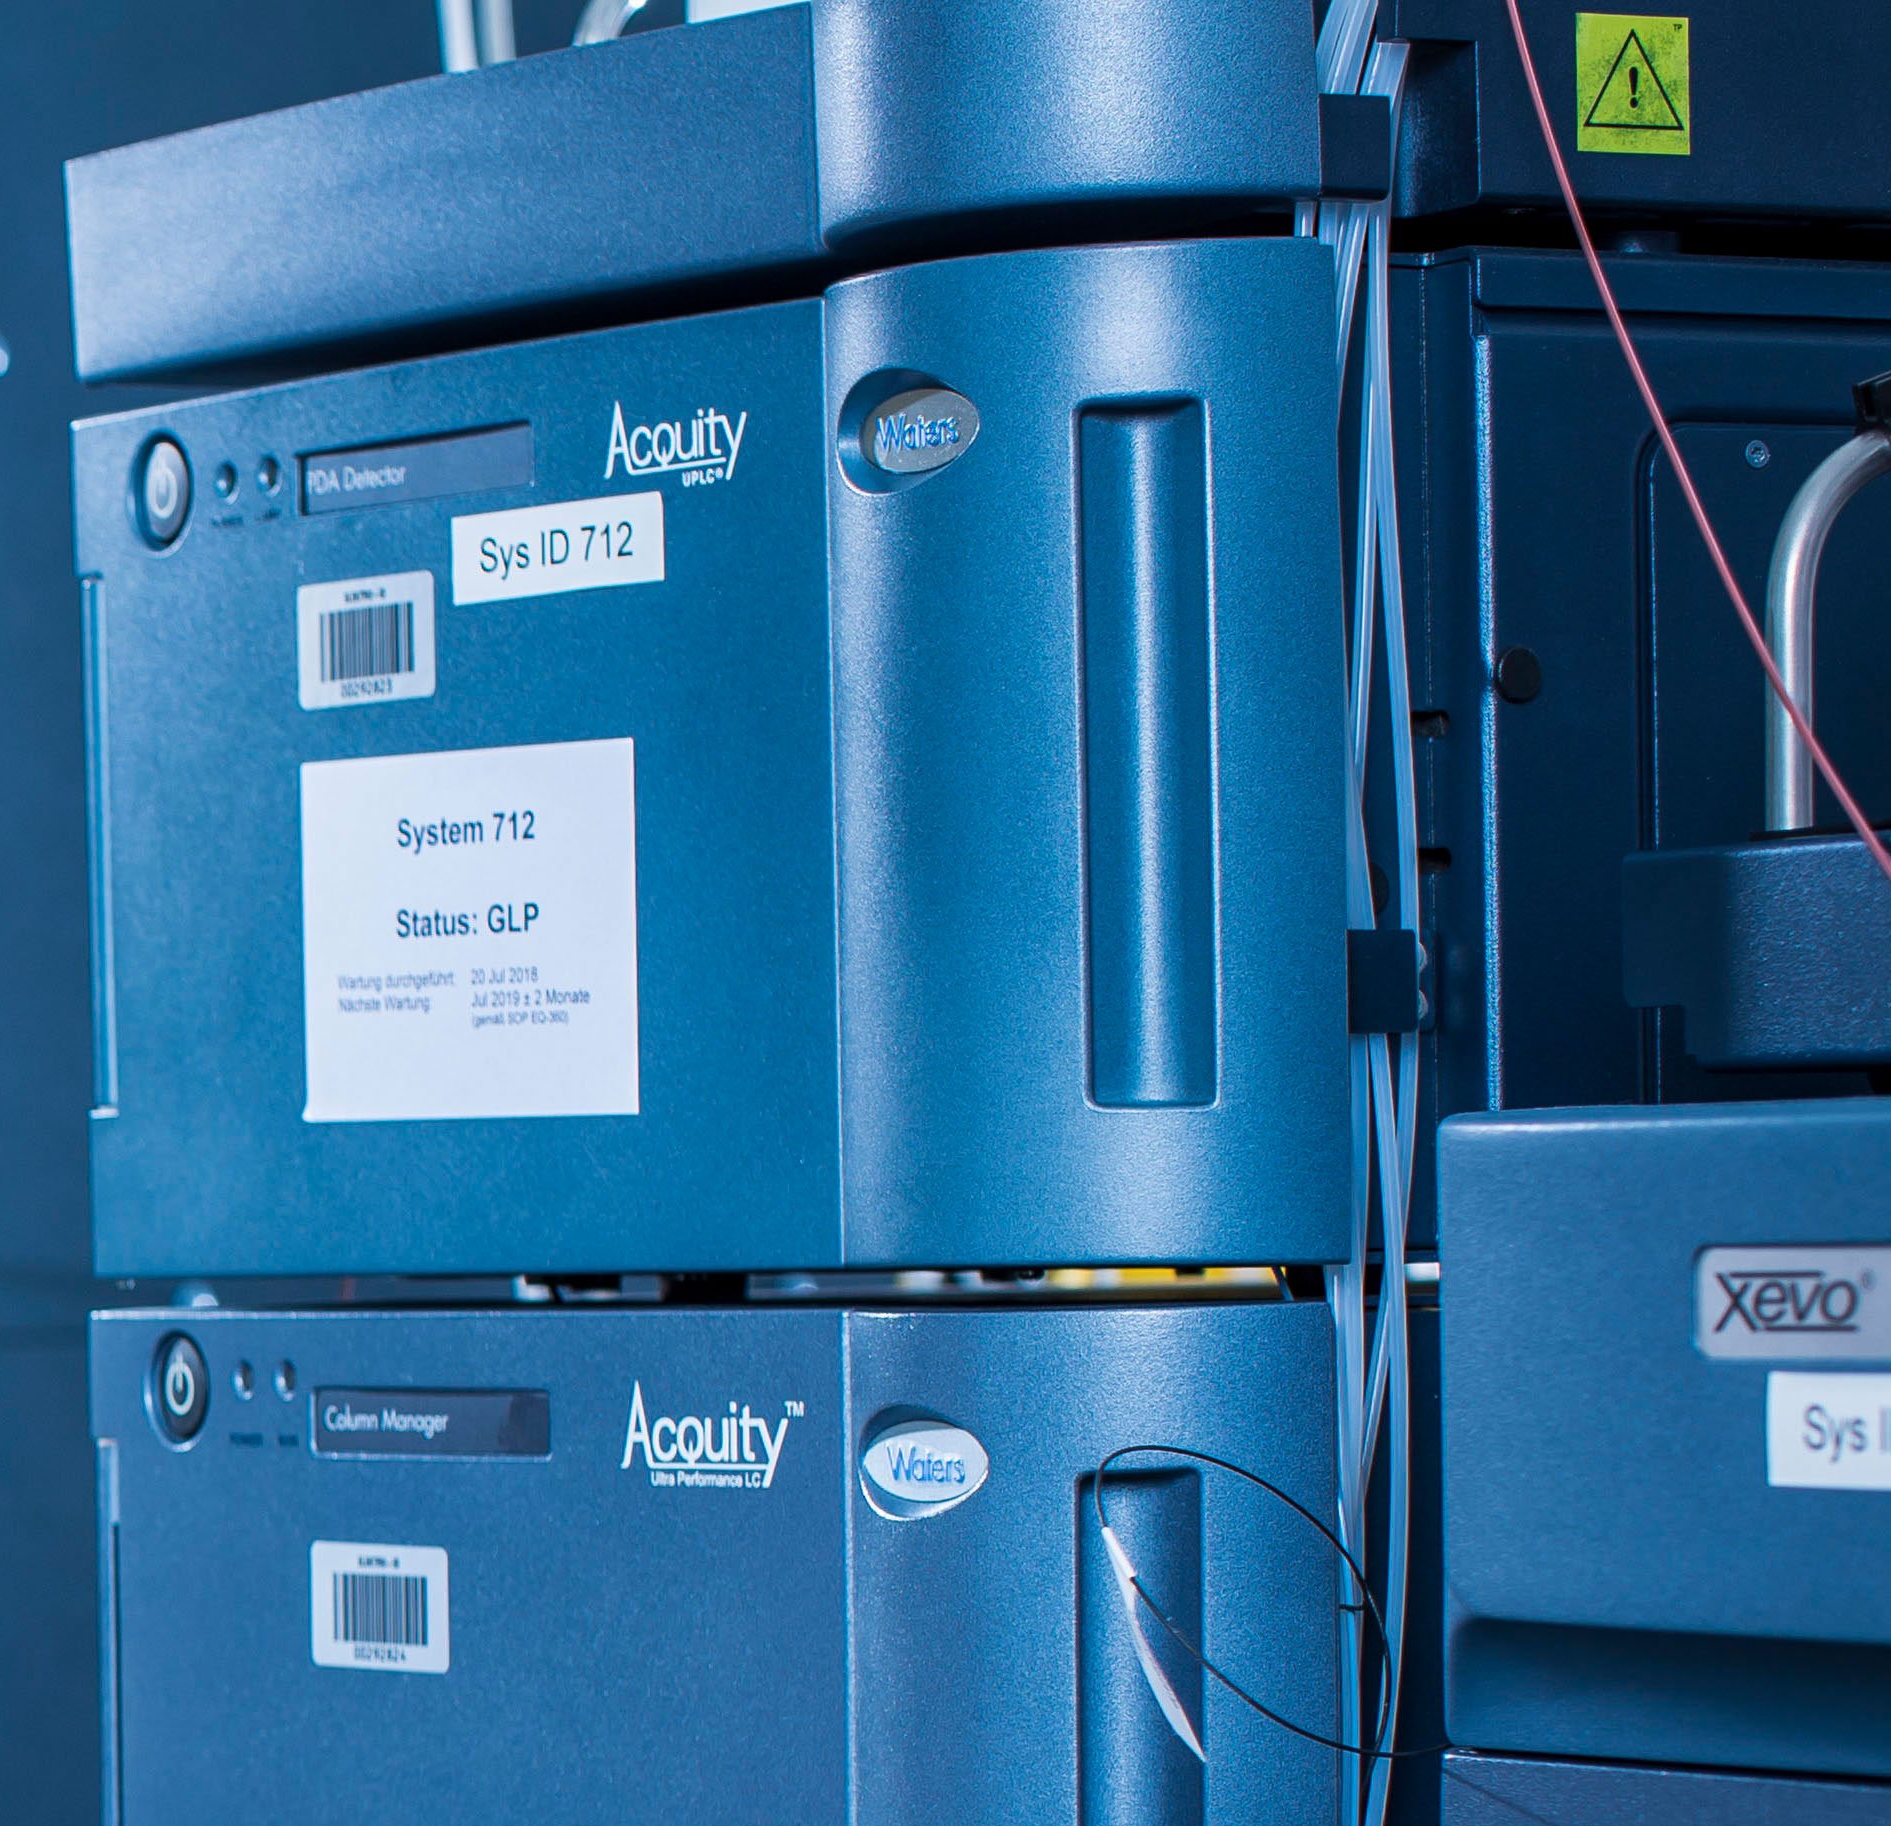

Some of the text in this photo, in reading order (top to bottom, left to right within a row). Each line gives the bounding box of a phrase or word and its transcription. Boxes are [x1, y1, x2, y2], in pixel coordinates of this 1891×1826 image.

[603, 400, 747, 481] Acquity
[875, 411, 961, 453] Waters
[343, 464, 407, 492] Detector
[479, 520, 634, 581] Sys ID 712
[396, 810, 536, 856] System 712
[396, 902, 540, 939] Status: GLP
[489, 967, 506, 985] Jul
[471, 990, 488, 1008] Jul
[491, 989, 521, 1008] 2019
[534, 988, 542, 1006] 2
[546, 987, 591, 1005] Monate
[323, 1402, 449, 1440] Column Manager
[1802, 1402, 1869, 1464] Sys
[650, 1470, 761, 1488] Ultra Performance LC
[885, 1443, 966, 1485] Waters
